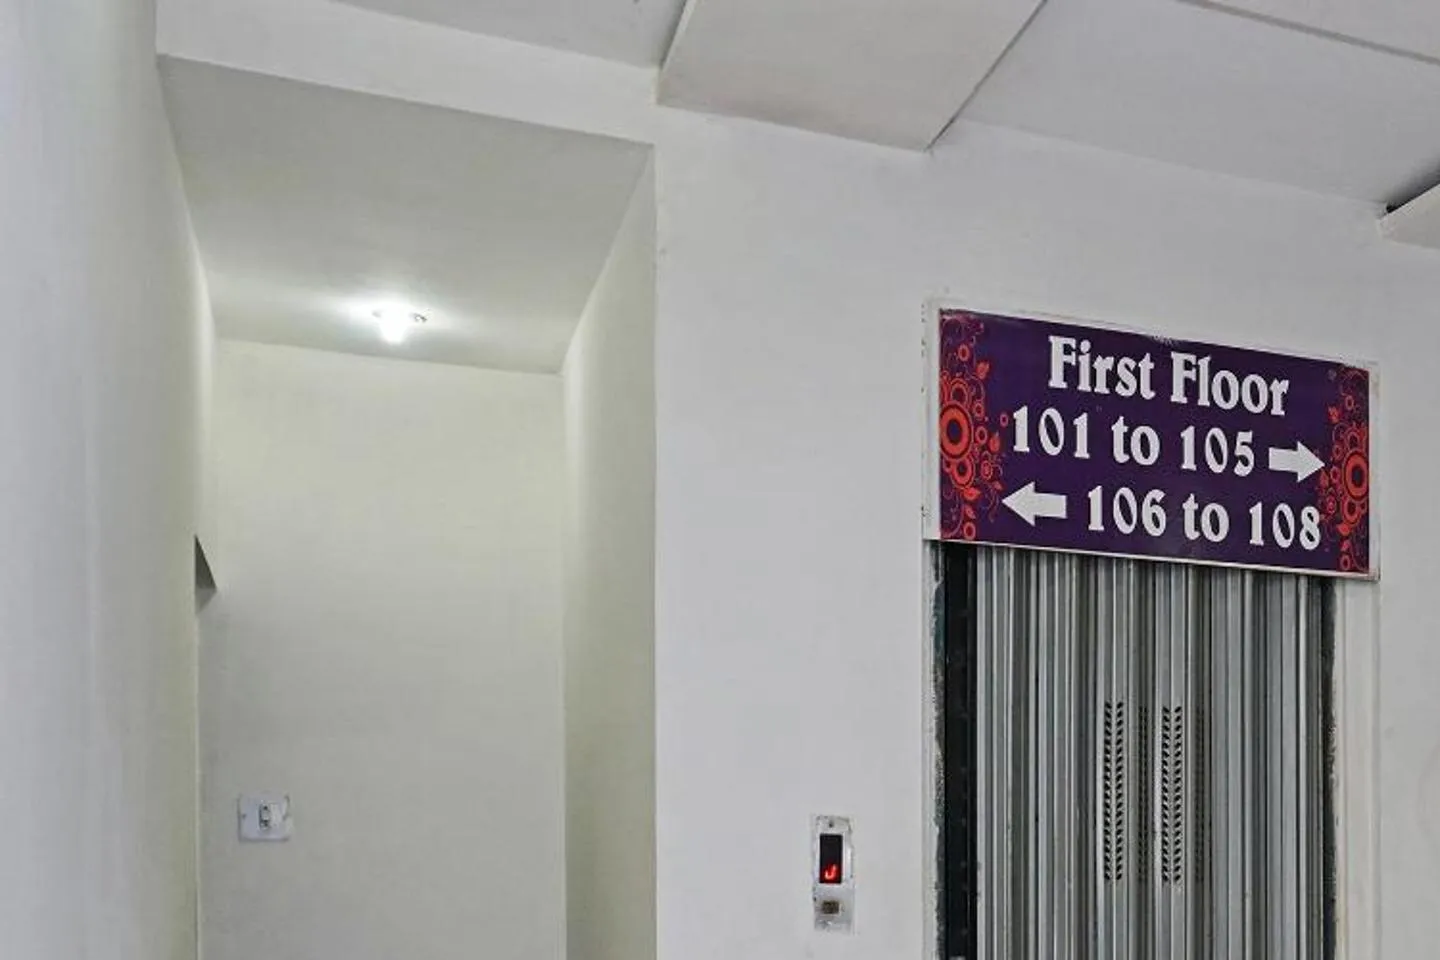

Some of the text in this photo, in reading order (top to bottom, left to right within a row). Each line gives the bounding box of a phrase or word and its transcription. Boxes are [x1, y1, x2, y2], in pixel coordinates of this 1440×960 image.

[1048, 335, 1290, 417] First Floor
[1013, 406, 1255, 478] 101 to 105
[1087, 485, 1321, 551] 106 to 108
